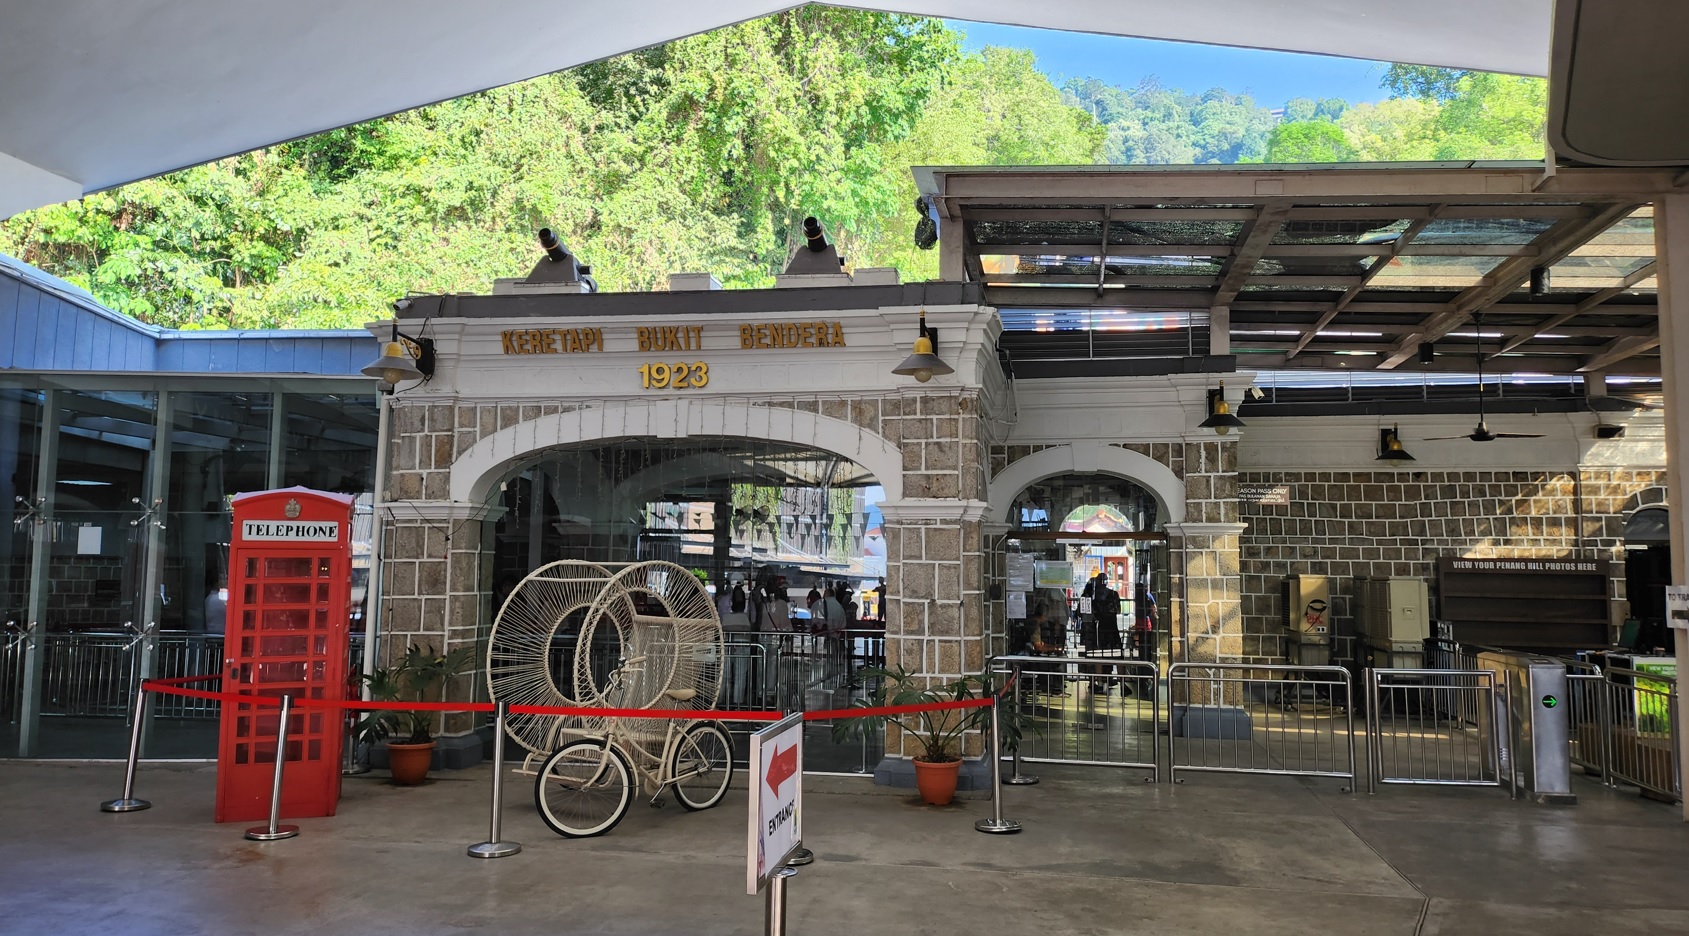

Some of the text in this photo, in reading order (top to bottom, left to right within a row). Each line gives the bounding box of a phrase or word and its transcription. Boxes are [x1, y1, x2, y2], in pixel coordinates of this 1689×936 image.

[501, 321, 846, 354] KERETAPI BUKIT BENDERA
[637, 361, 708, 389] 1923
[246, 523, 338, 538] TELEPHONE
[1452, 560, 1597, 571] VIEW YOUR PENANG HILL PHOTOS HERE
[1667, 593, 1676, 601] TO
